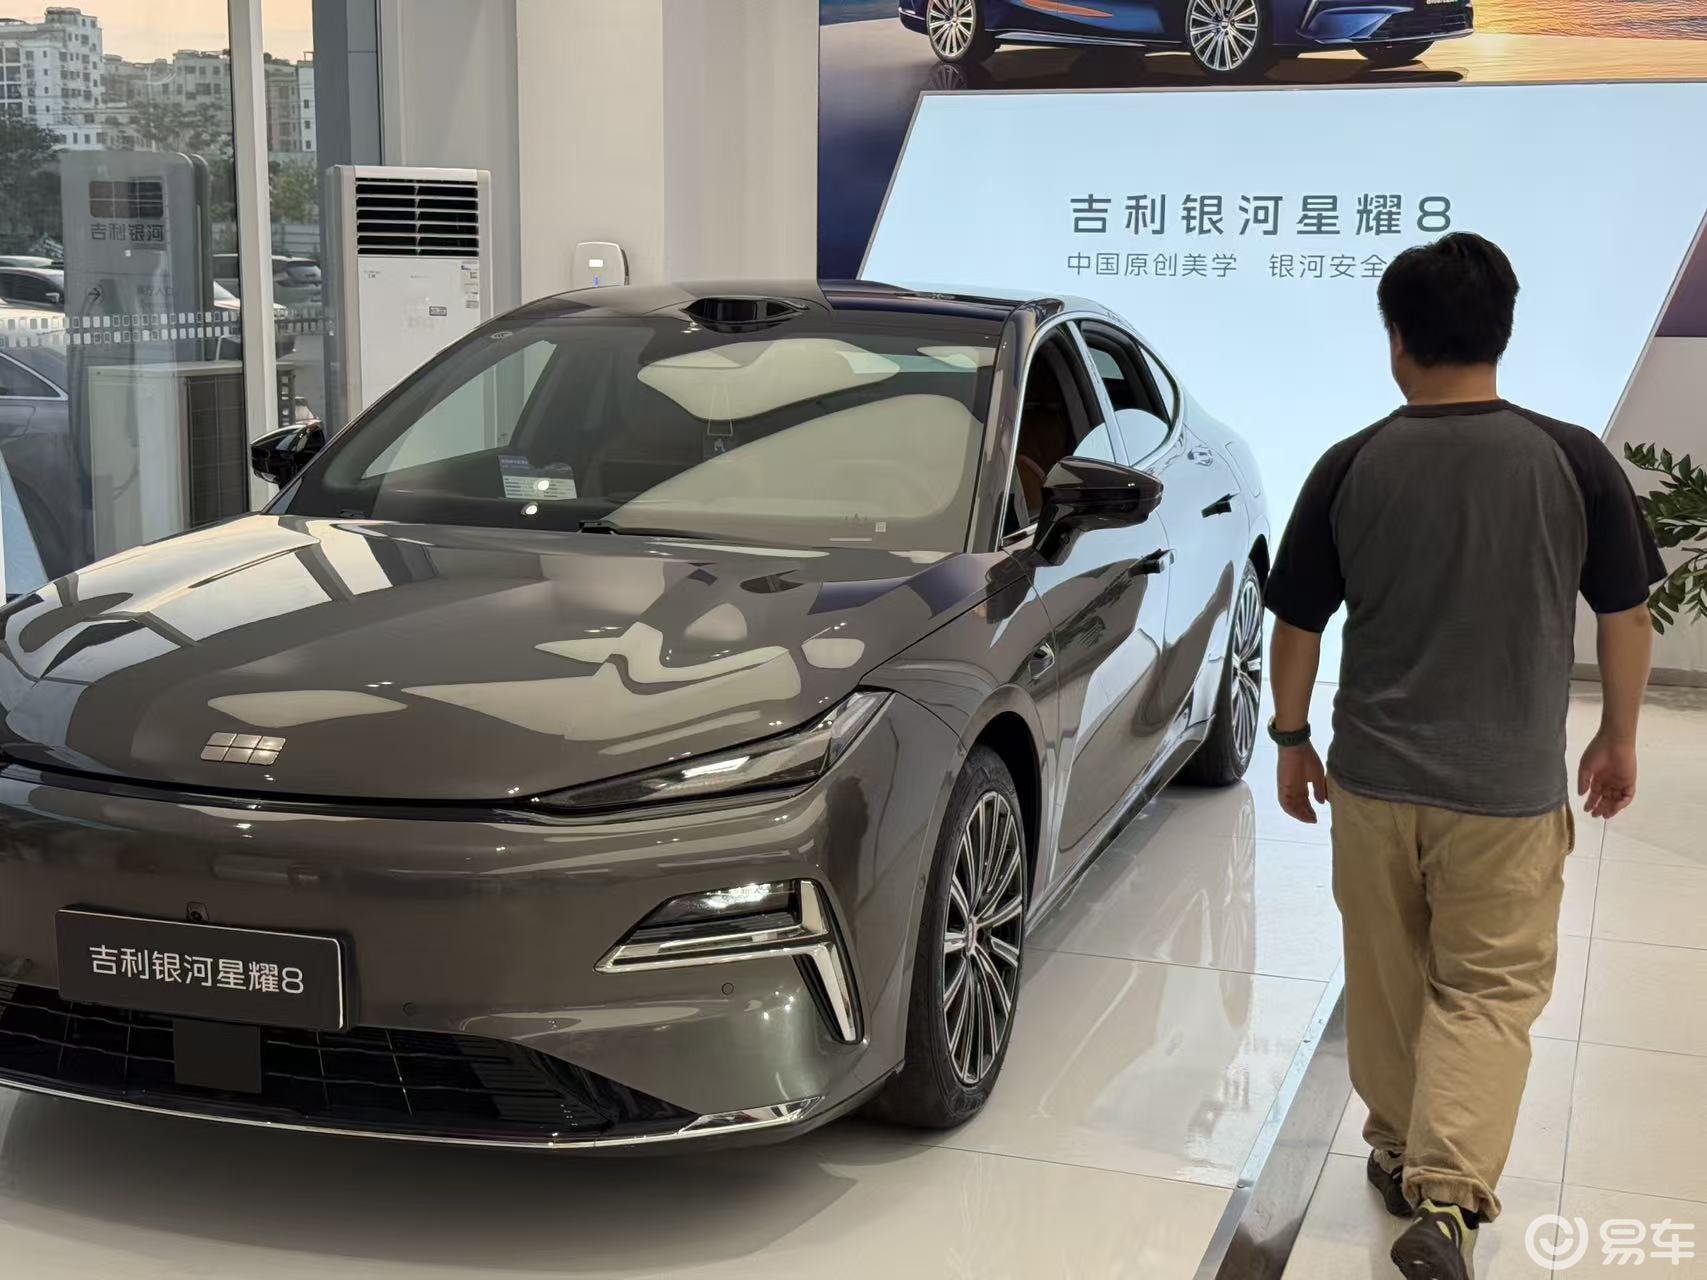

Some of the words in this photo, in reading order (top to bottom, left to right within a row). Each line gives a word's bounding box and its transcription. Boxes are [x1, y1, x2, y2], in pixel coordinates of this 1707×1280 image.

[90, 222, 165, 242] 吉利银河
[1069, 192, 1452, 236] 吉利银河星耀8
[1066, 251, 1238, 278] 中国原创美学
[1268, 253, 1396, 279] 银河安全
[89, 944, 305, 995] 吉利银河星耀8
